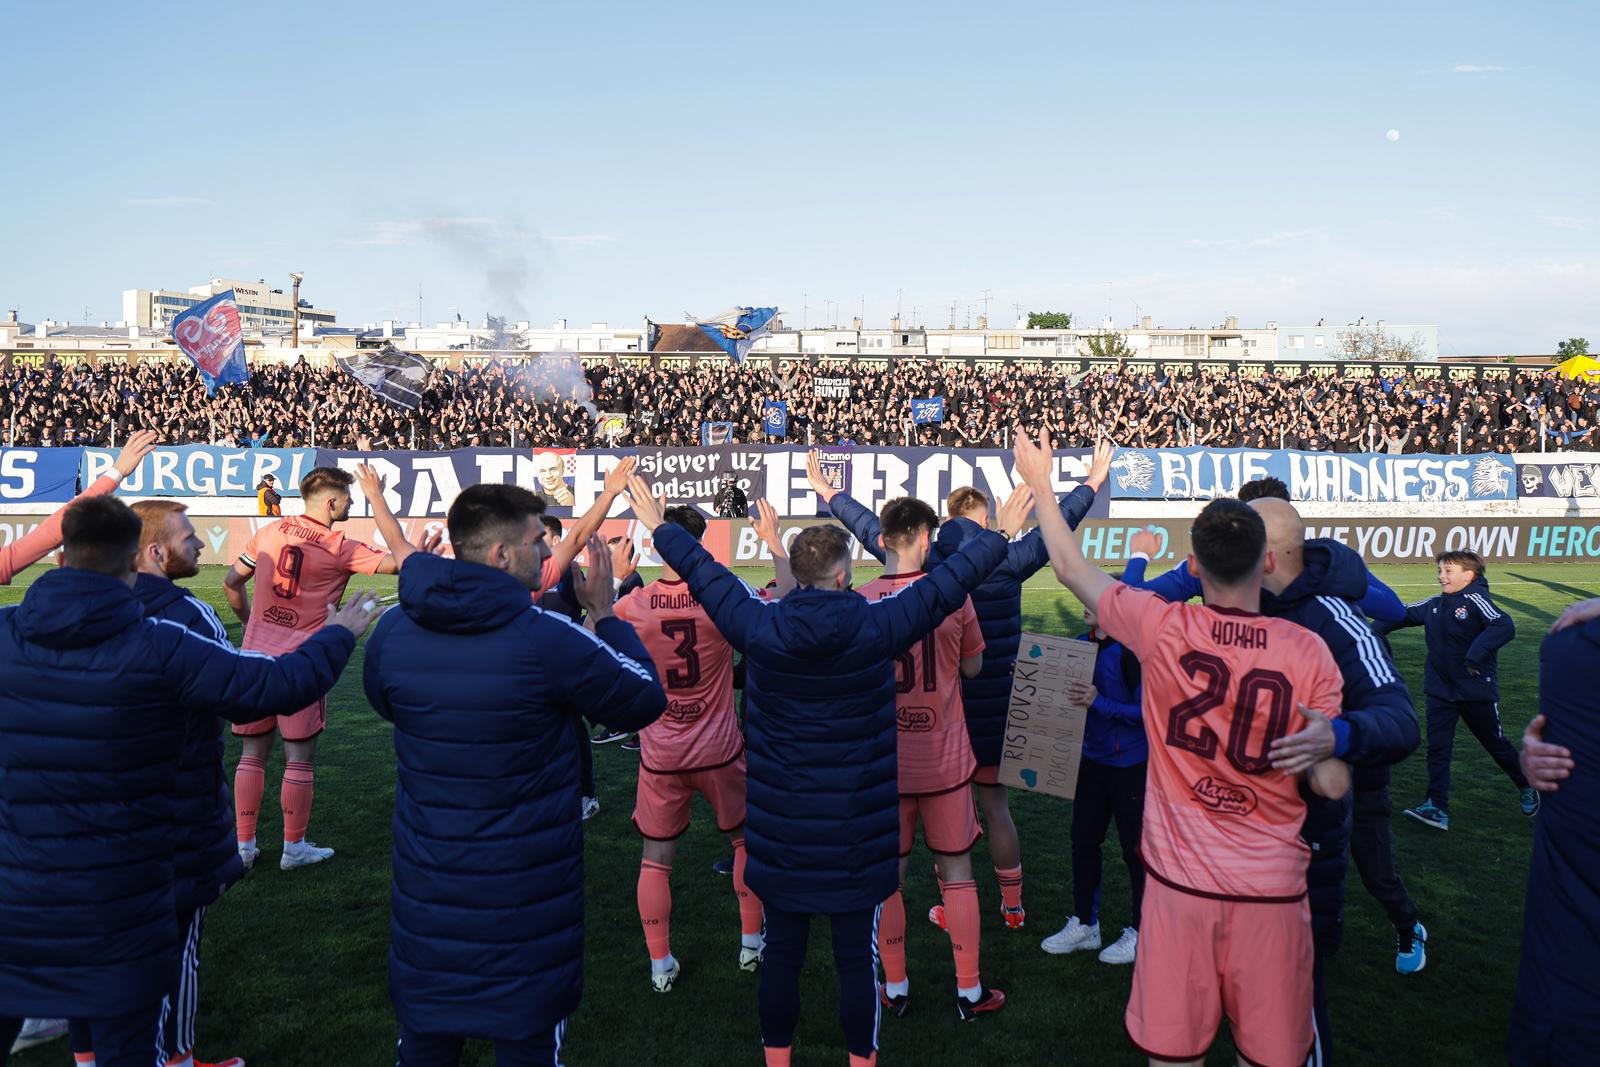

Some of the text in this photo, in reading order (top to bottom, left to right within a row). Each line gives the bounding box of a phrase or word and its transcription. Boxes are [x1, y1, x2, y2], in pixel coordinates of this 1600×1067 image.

[235, 287, 258, 296] WESTIN
[813, 377, 850, 386] TRADICIJA
[814, 386, 850, 398] BUNTA
[85, 450, 304, 496] PURGERI
[641, 451, 762, 477] sjever uz
[1158, 451, 1470, 502] BLUE MADNESS
[1356, 526, 1436, 558] YOUR
[1445, 526, 1519, 558] OWN
[272, 544, 304, 599] 9
[1212, 620, 1268, 650] HOXHA
[661, 618, 700, 689] 3
[1004, 660, 1039, 761] RISTOVSKI
[1037, 687, 1056, 716] MOJ
[1166, 650, 1293, 775] 20
[1033, 724, 1048, 737] SI
[1029, 746, 1045, 761] TI
[1047, 728, 1074, 789] POKLONI
